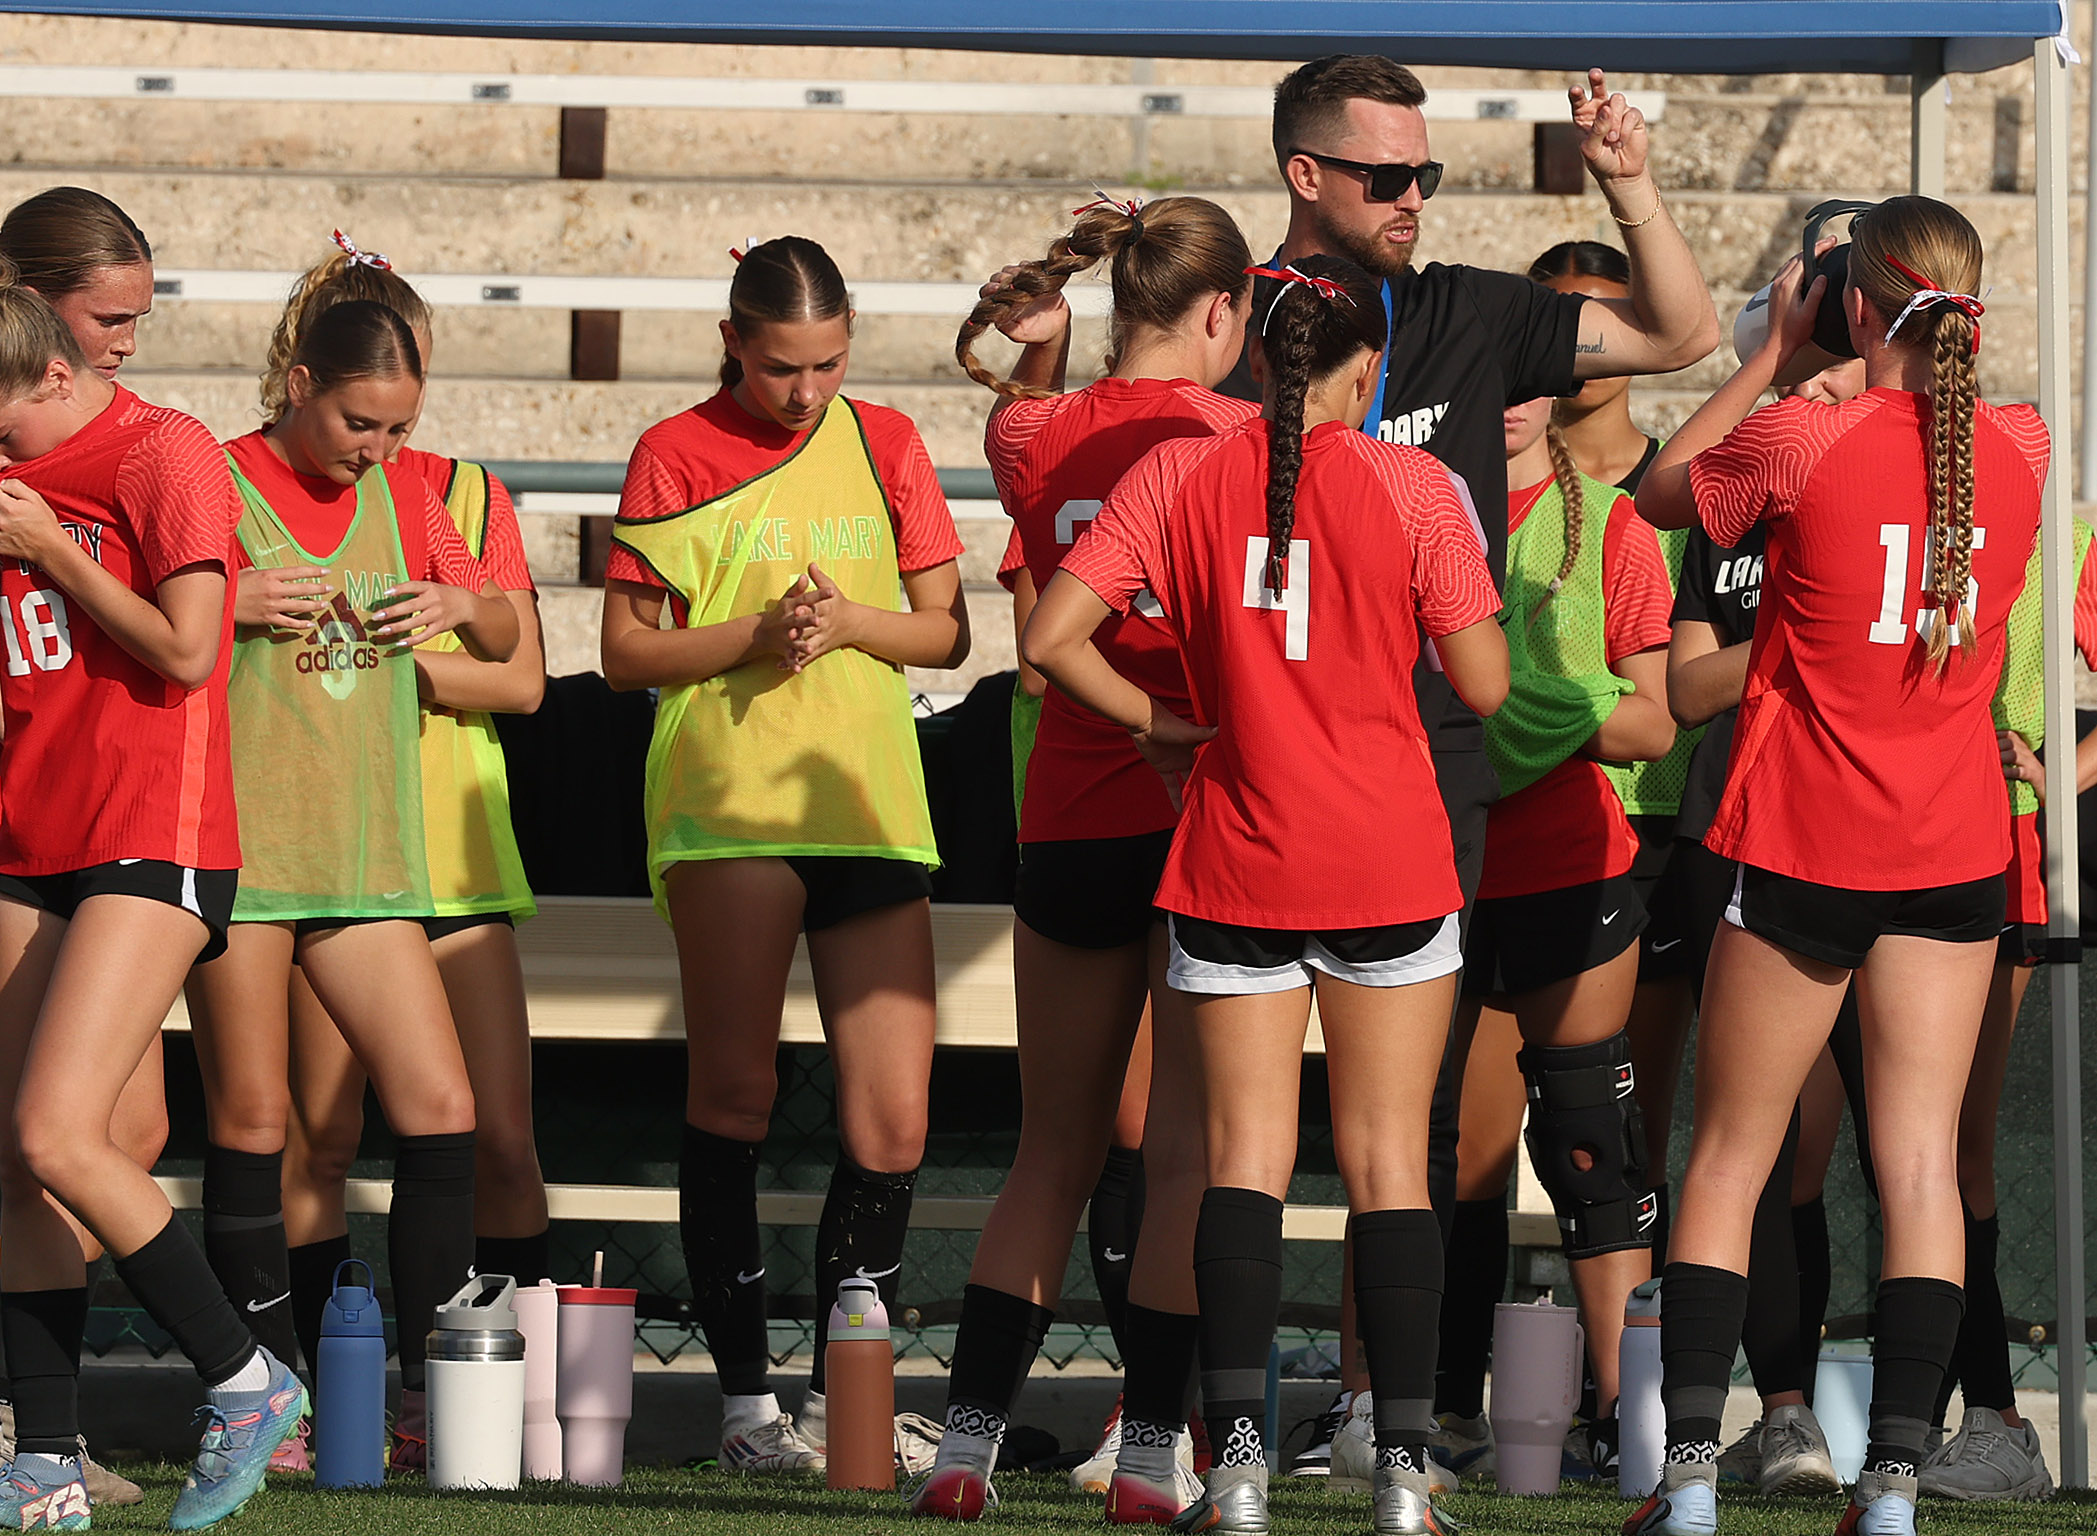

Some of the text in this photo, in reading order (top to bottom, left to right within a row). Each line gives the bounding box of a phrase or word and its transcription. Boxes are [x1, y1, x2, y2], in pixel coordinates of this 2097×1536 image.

[711, 515, 882, 566] LAKE MARY
[344, 569, 399, 612] MA
[1714, 554, 1764, 594] LAK
[1242, 535, 1310, 661] 4
[1741, 589, 1761, 610] GI
[0, 589, 73, 677] 18
[295, 641, 379, 674] adidas
